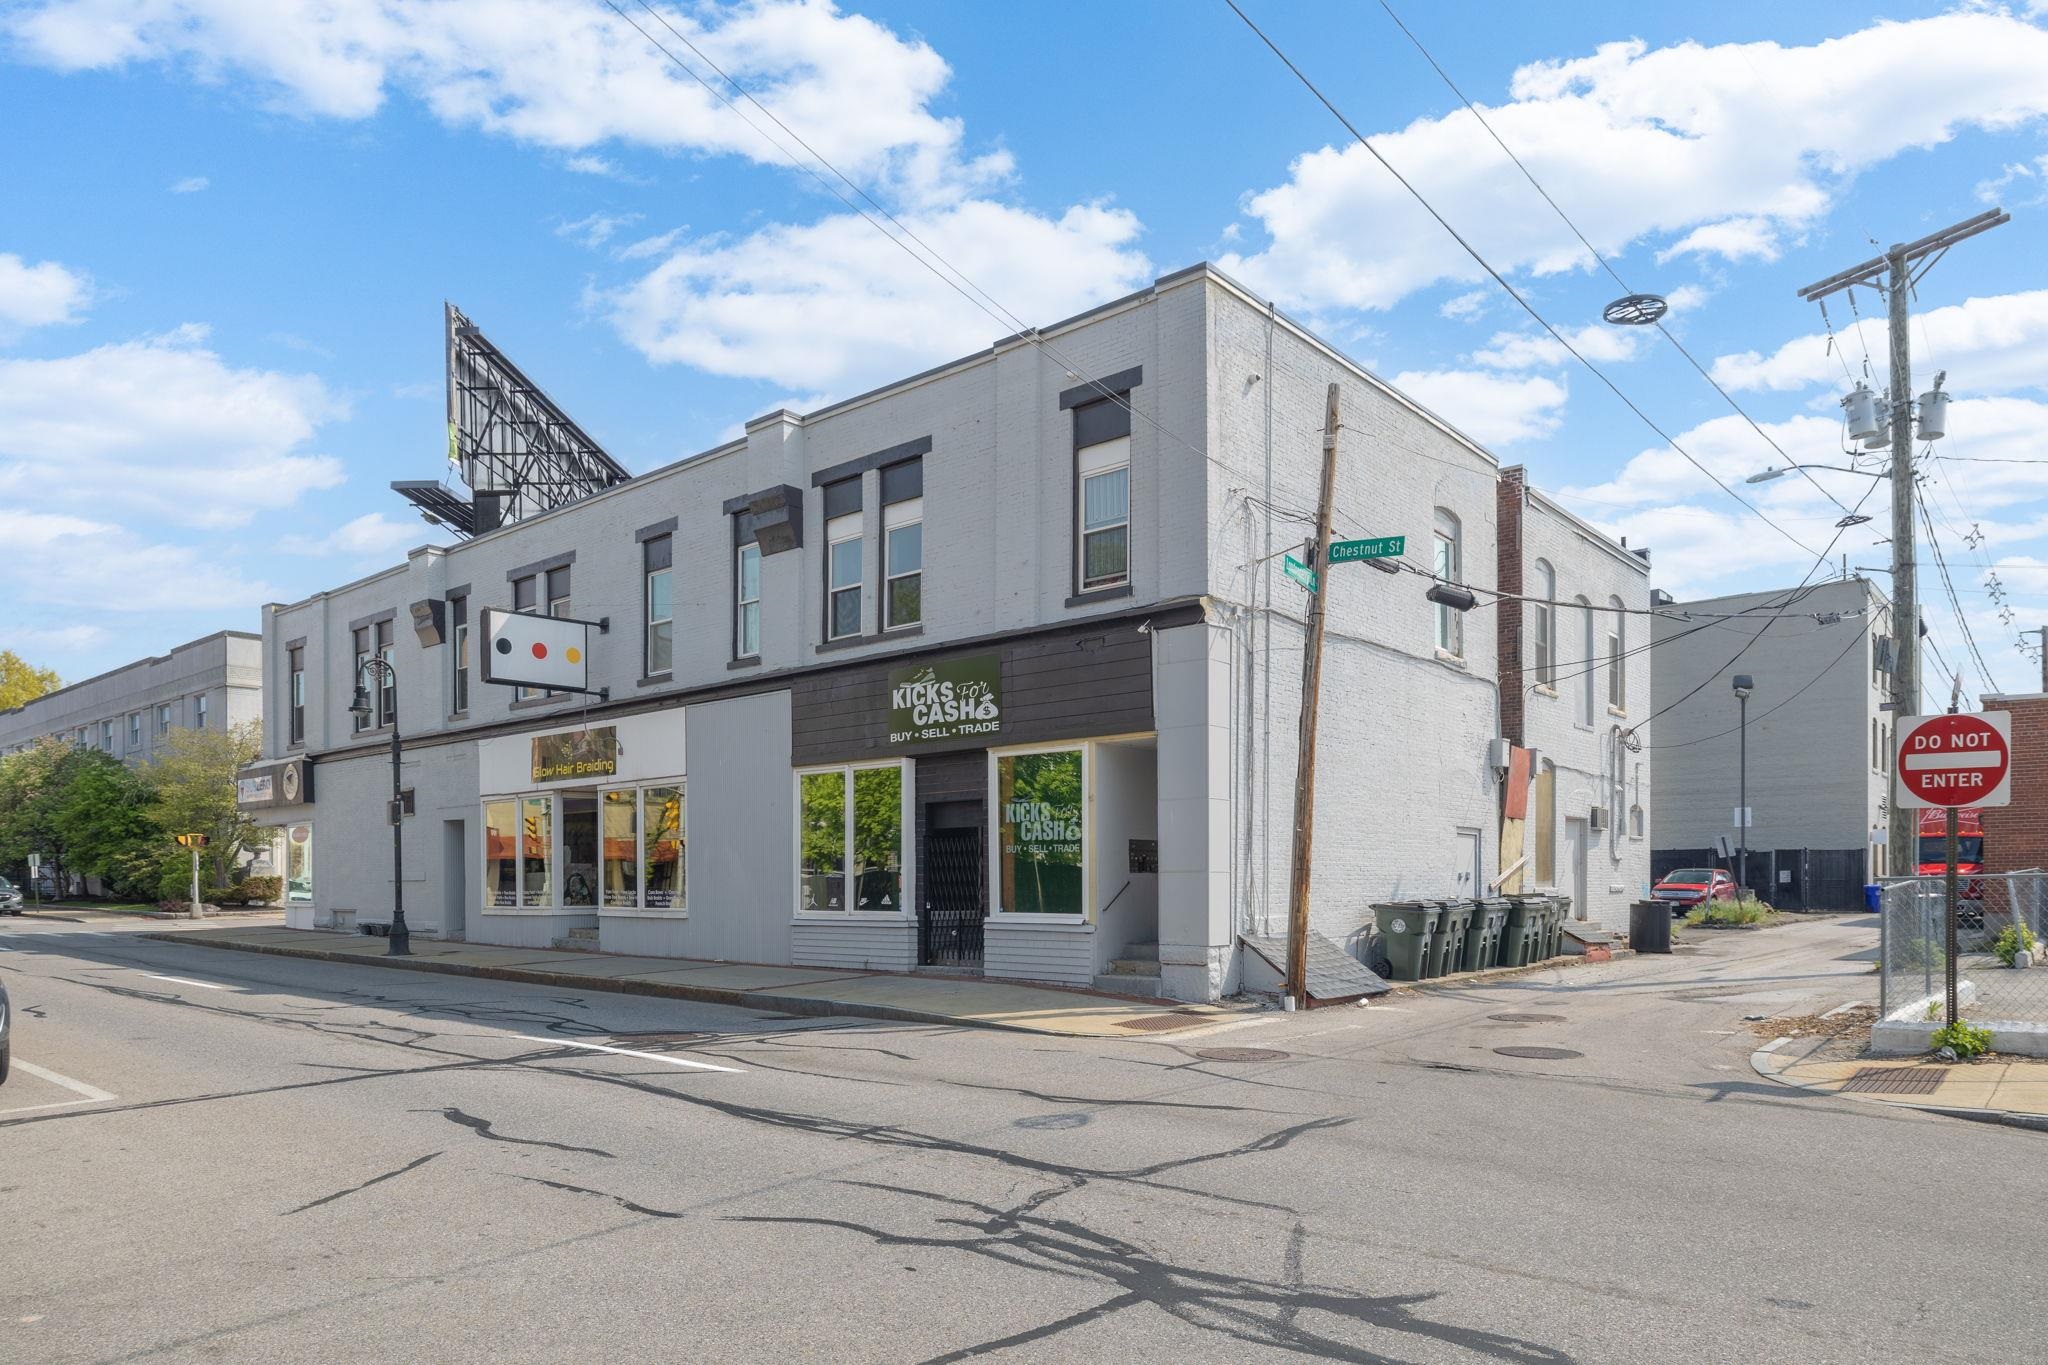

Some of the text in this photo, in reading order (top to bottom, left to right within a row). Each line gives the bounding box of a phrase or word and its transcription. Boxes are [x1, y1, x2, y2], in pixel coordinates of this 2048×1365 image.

[1332, 540, 1401, 558] Chestnut St
[892, 681, 990, 710] KICKS For
[912, 698, 975, 726] CASH
[890, 721, 1000, 743] BUY SELL TRADE
[1914, 732, 1991, 750] DO NOT
[556, 763, 575, 776] Hair
[576, 758, 614, 773] Braiding
[1921, 772, 1983, 788] ENTER
[1005, 802, 1051, 823] KICKS
[1021, 820, 1065, 841] CASH
[1006, 843, 1080, 854] BUY SELL TRADE
